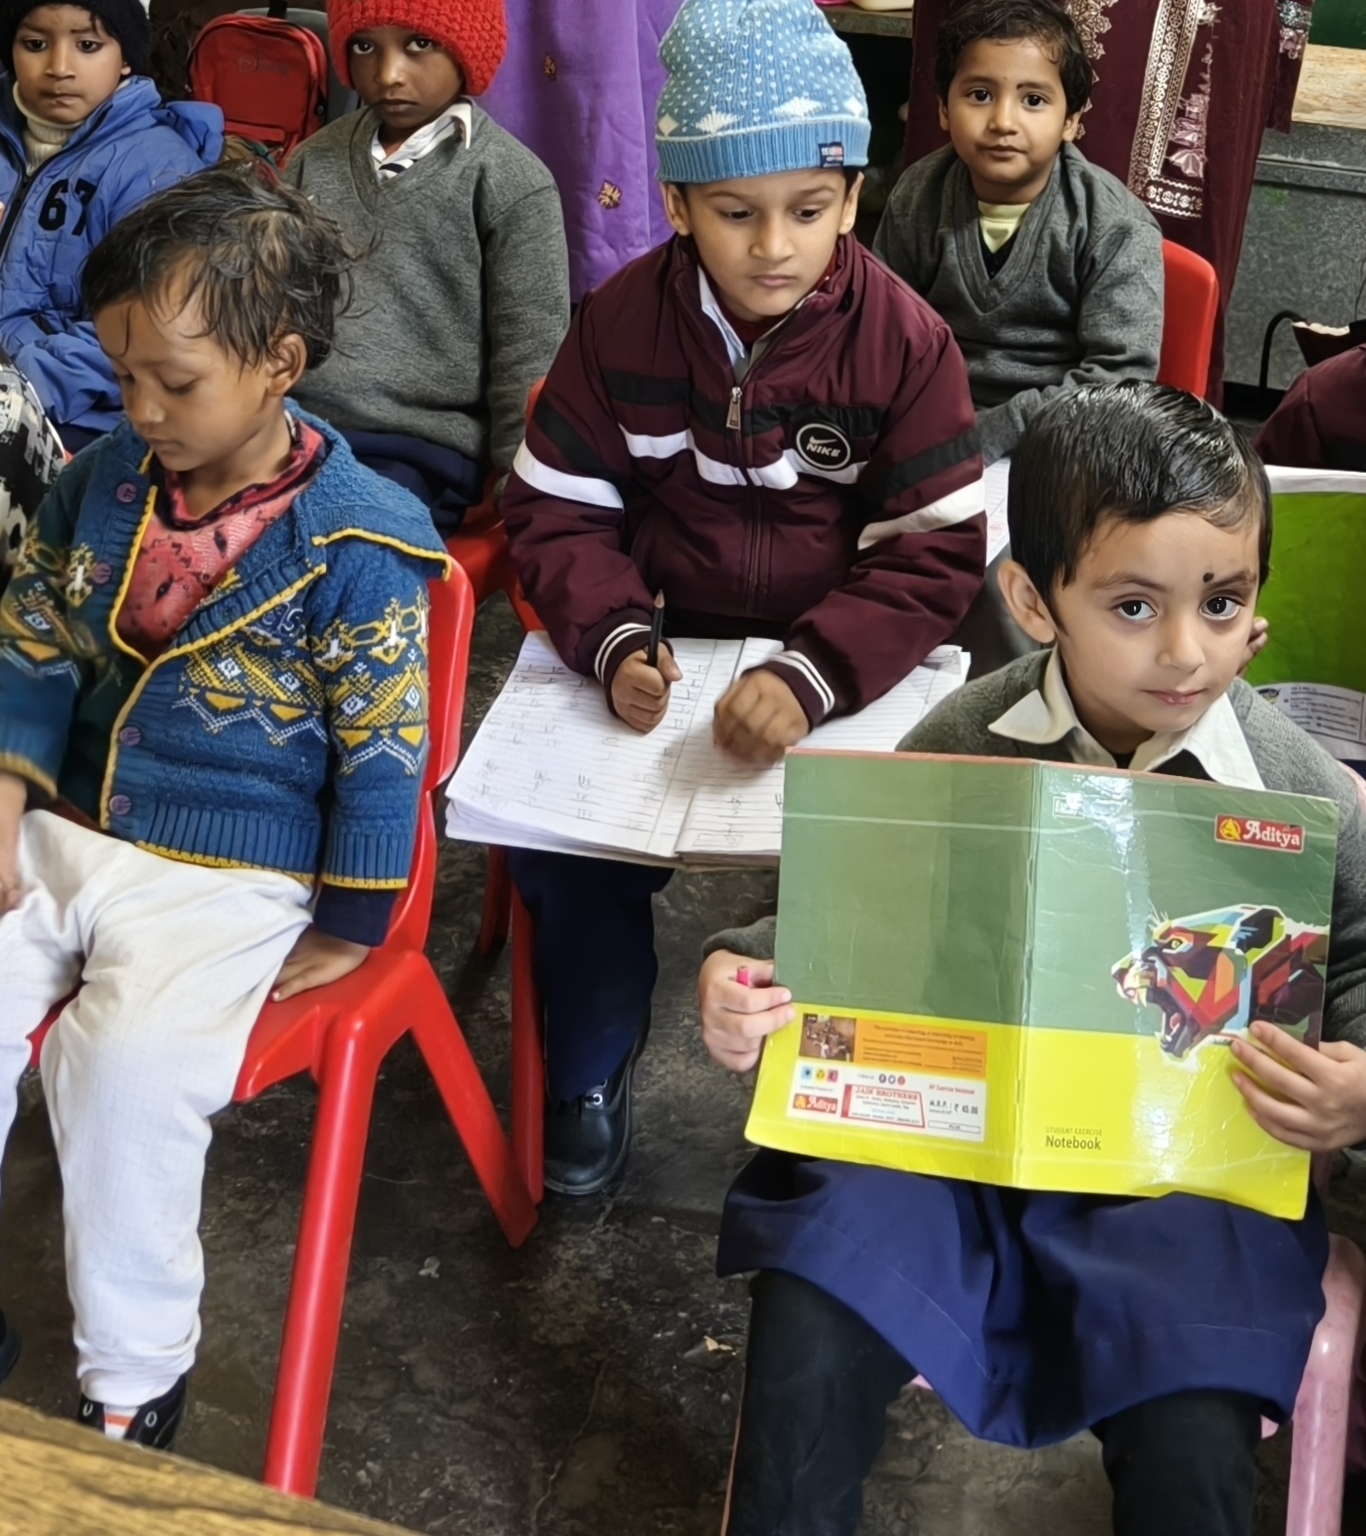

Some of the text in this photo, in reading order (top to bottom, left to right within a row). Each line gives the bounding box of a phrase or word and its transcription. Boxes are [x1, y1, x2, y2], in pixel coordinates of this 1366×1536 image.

[38, 178, 97, 237] 67
[806, 443, 841, 457] NIKE
[1243, 821, 1301, 848] Aditya
[806, 1096, 837, 1112] Aditya
[1046, 1135, 1101, 1150] Notebook
